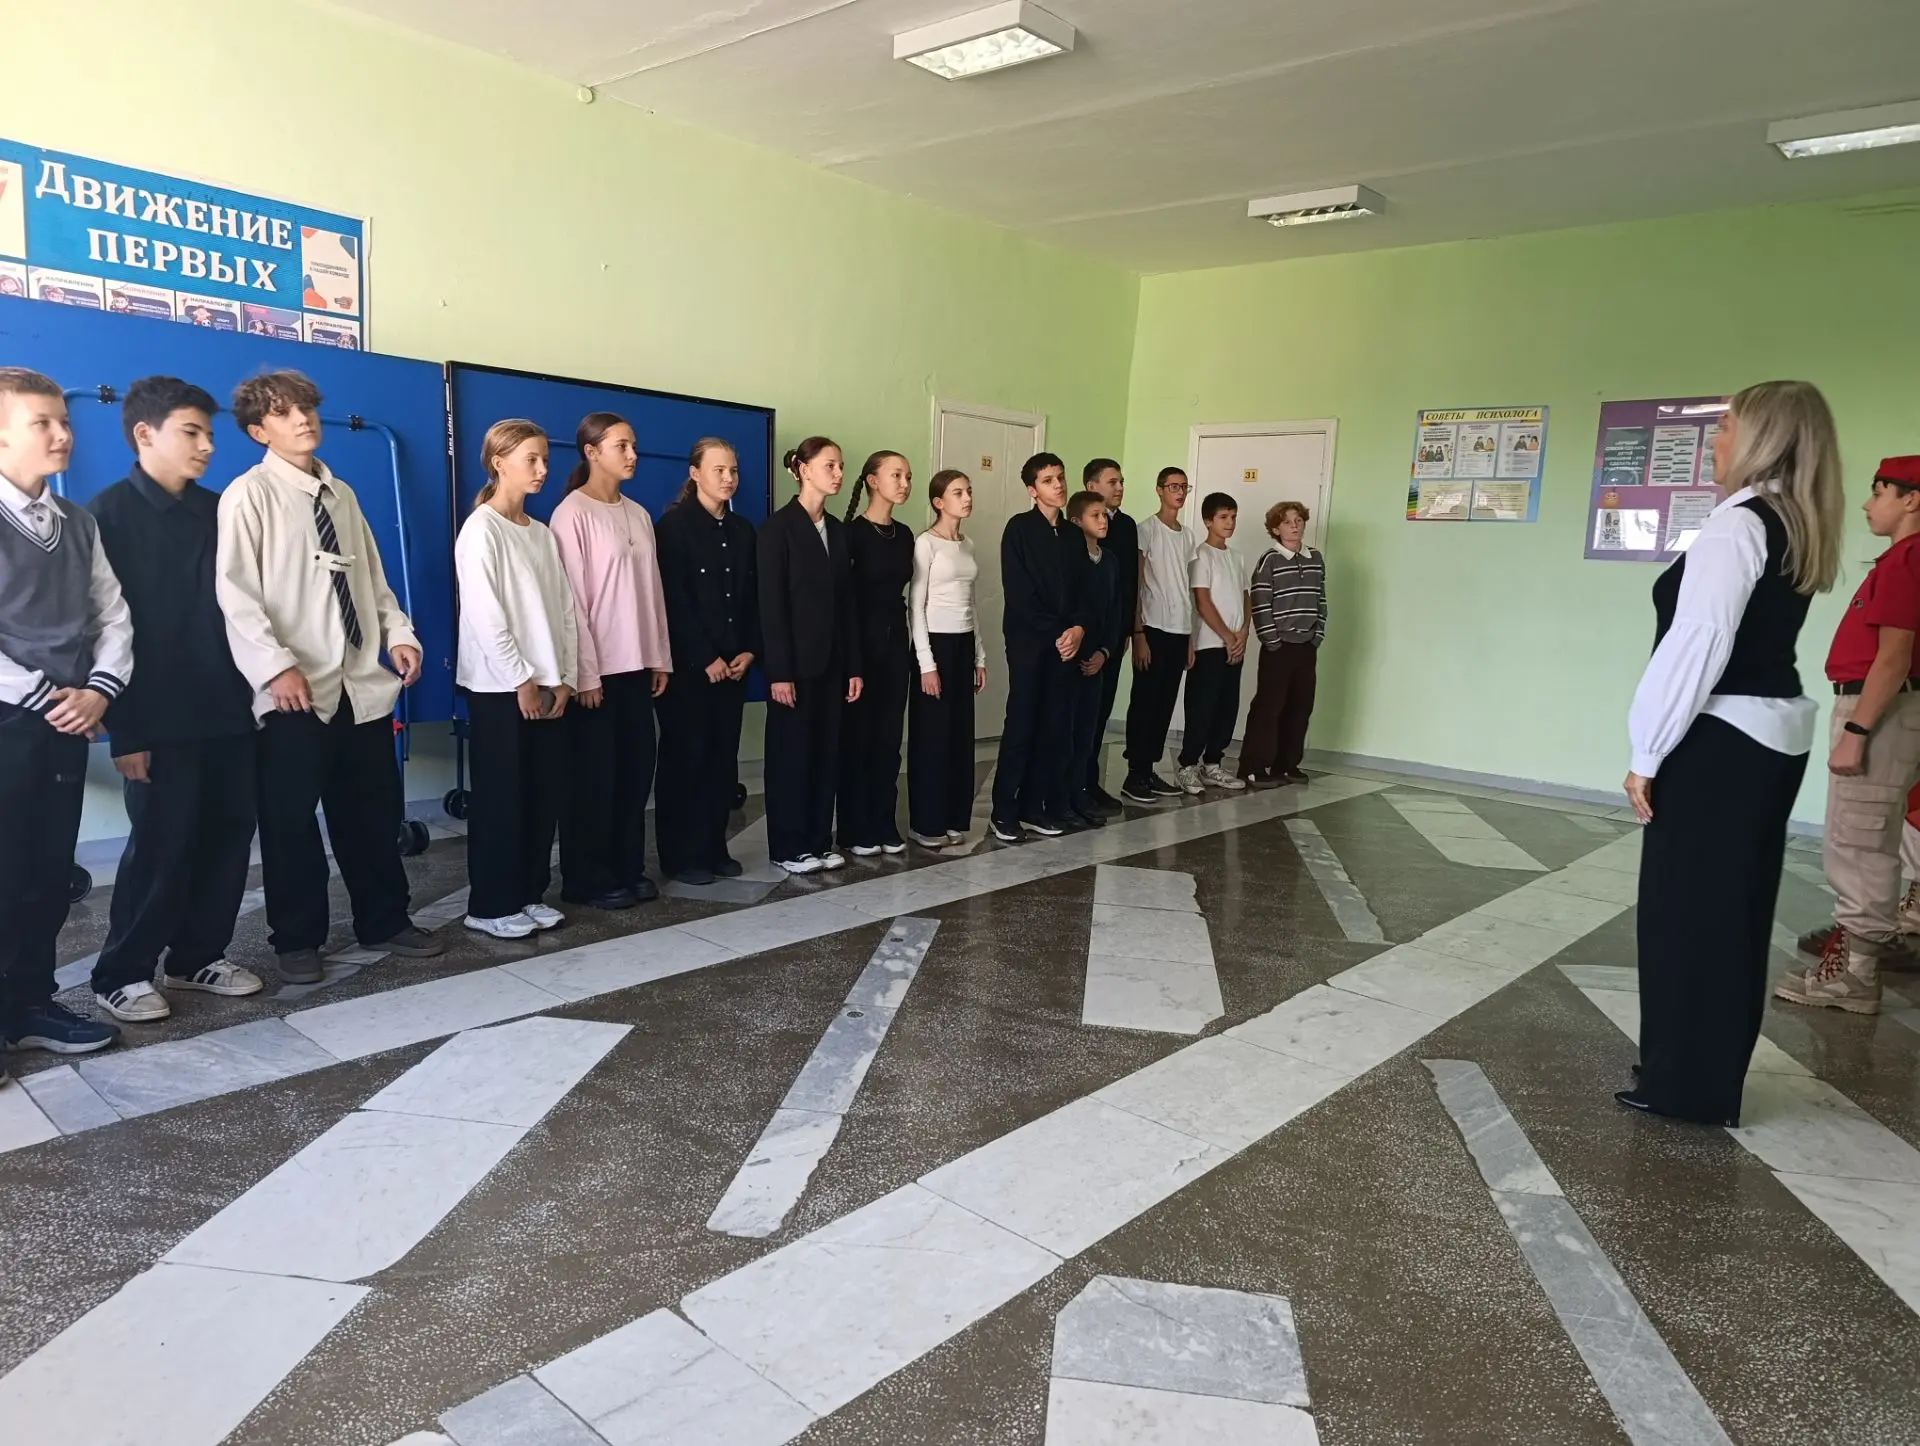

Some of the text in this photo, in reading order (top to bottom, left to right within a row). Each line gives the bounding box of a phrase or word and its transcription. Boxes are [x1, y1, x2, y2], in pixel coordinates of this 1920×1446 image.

[35, 160, 293, 251] ДВИЖЕНИЕ
[87, 228, 278, 292] ПЕРВЫХ
[1426, 409, 1538, 421] СОВЕТЫ ПСИХОЛОГА
[982, 458, 992, 467] 32
[1245, 471, 1256, 479] 31
